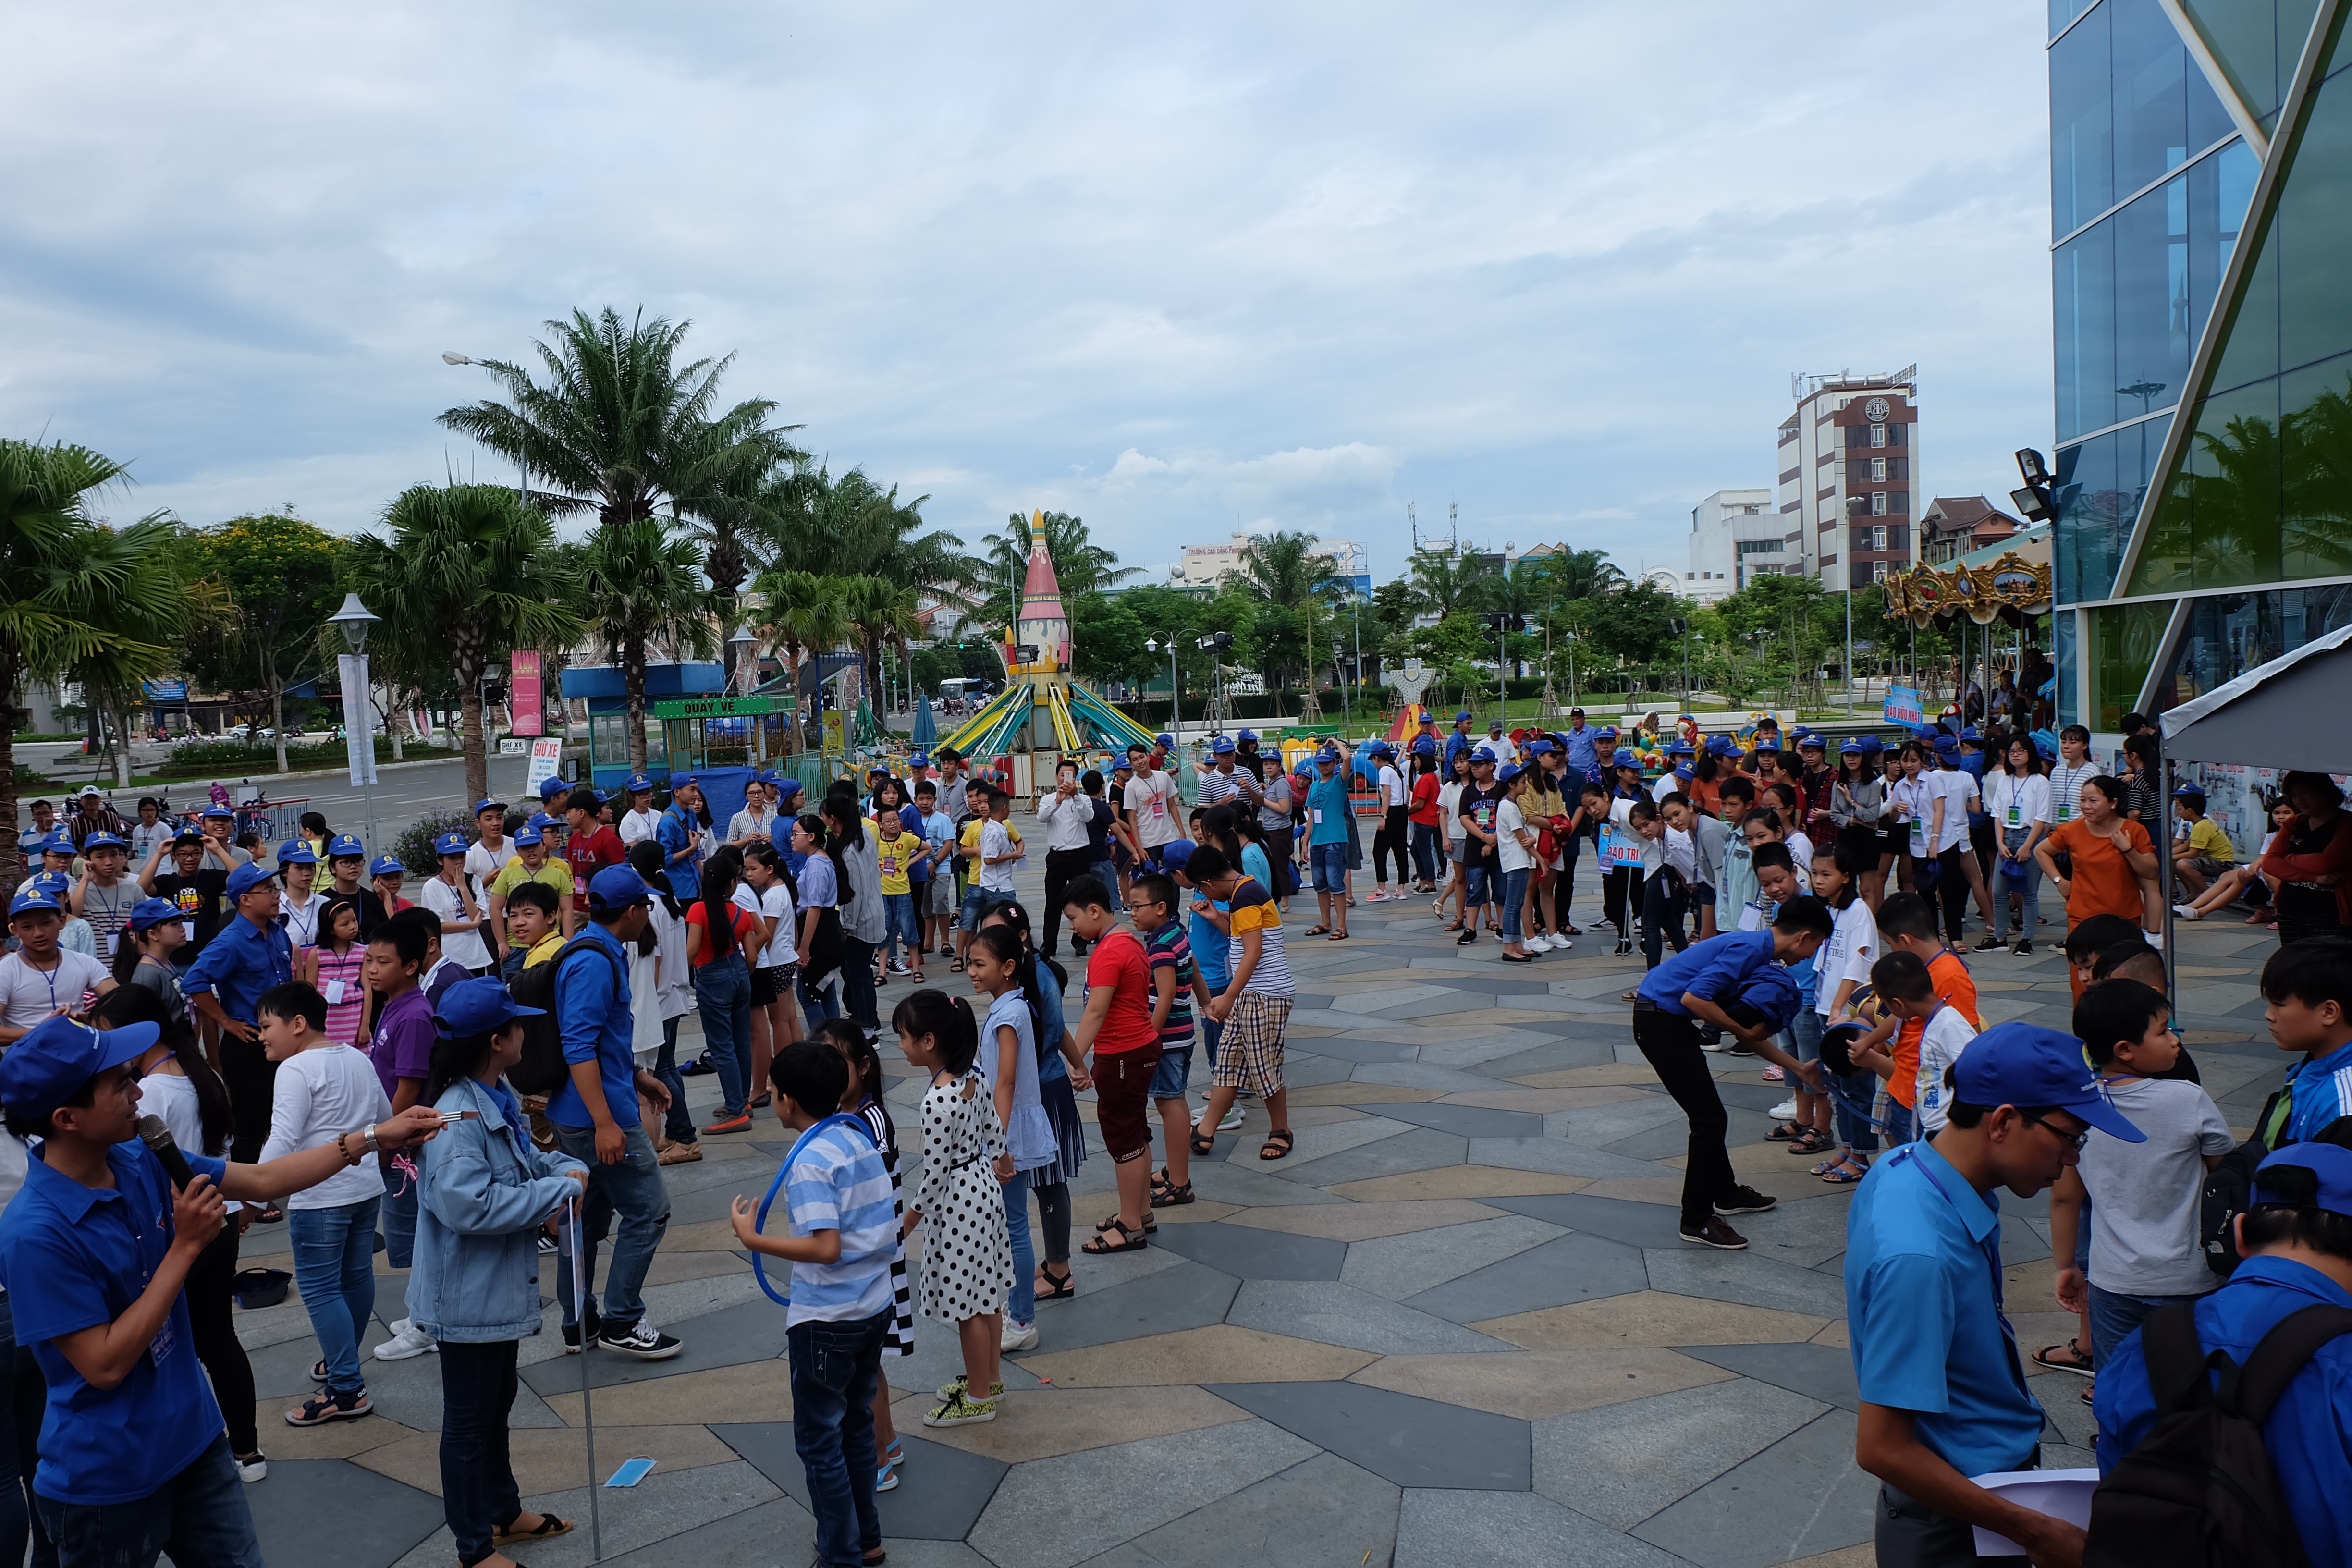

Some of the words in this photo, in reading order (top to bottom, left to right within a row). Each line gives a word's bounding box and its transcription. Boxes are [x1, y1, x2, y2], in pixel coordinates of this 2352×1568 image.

[721, 699, 735, 711] VÉ
[534, 740, 548, 757] GIỮ
[547, 744, 558, 757] XE
[572, 849, 596, 862] FILA
